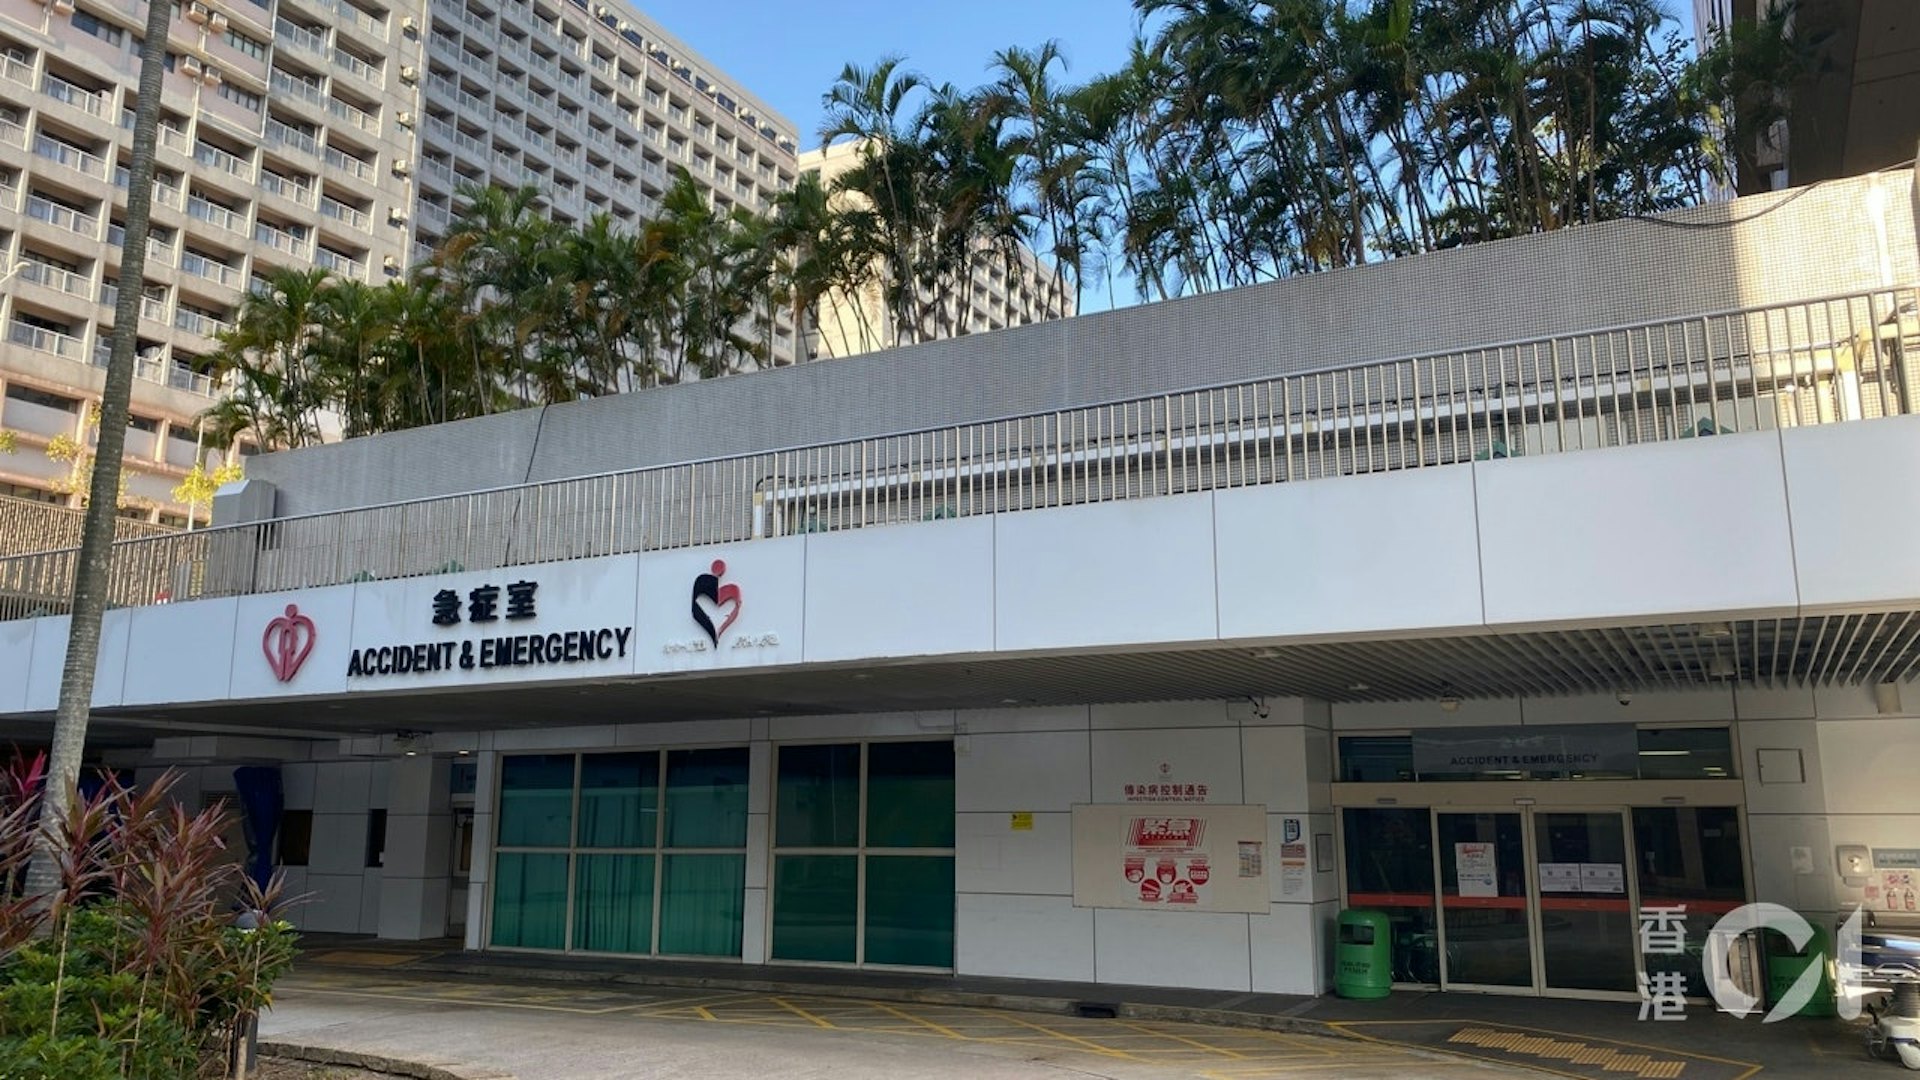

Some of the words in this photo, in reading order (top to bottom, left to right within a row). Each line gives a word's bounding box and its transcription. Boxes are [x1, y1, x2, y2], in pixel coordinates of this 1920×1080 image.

[432, 580, 539, 625] 急症室
[347, 641, 457, 677] ACCIDENT
[459, 640, 475, 670] &
[479, 626, 632, 668] EMERGENCY
[1451, 756, 1508, 765] ACCIDENT
[1522, 753, 1598, 764] EMERGENCY
